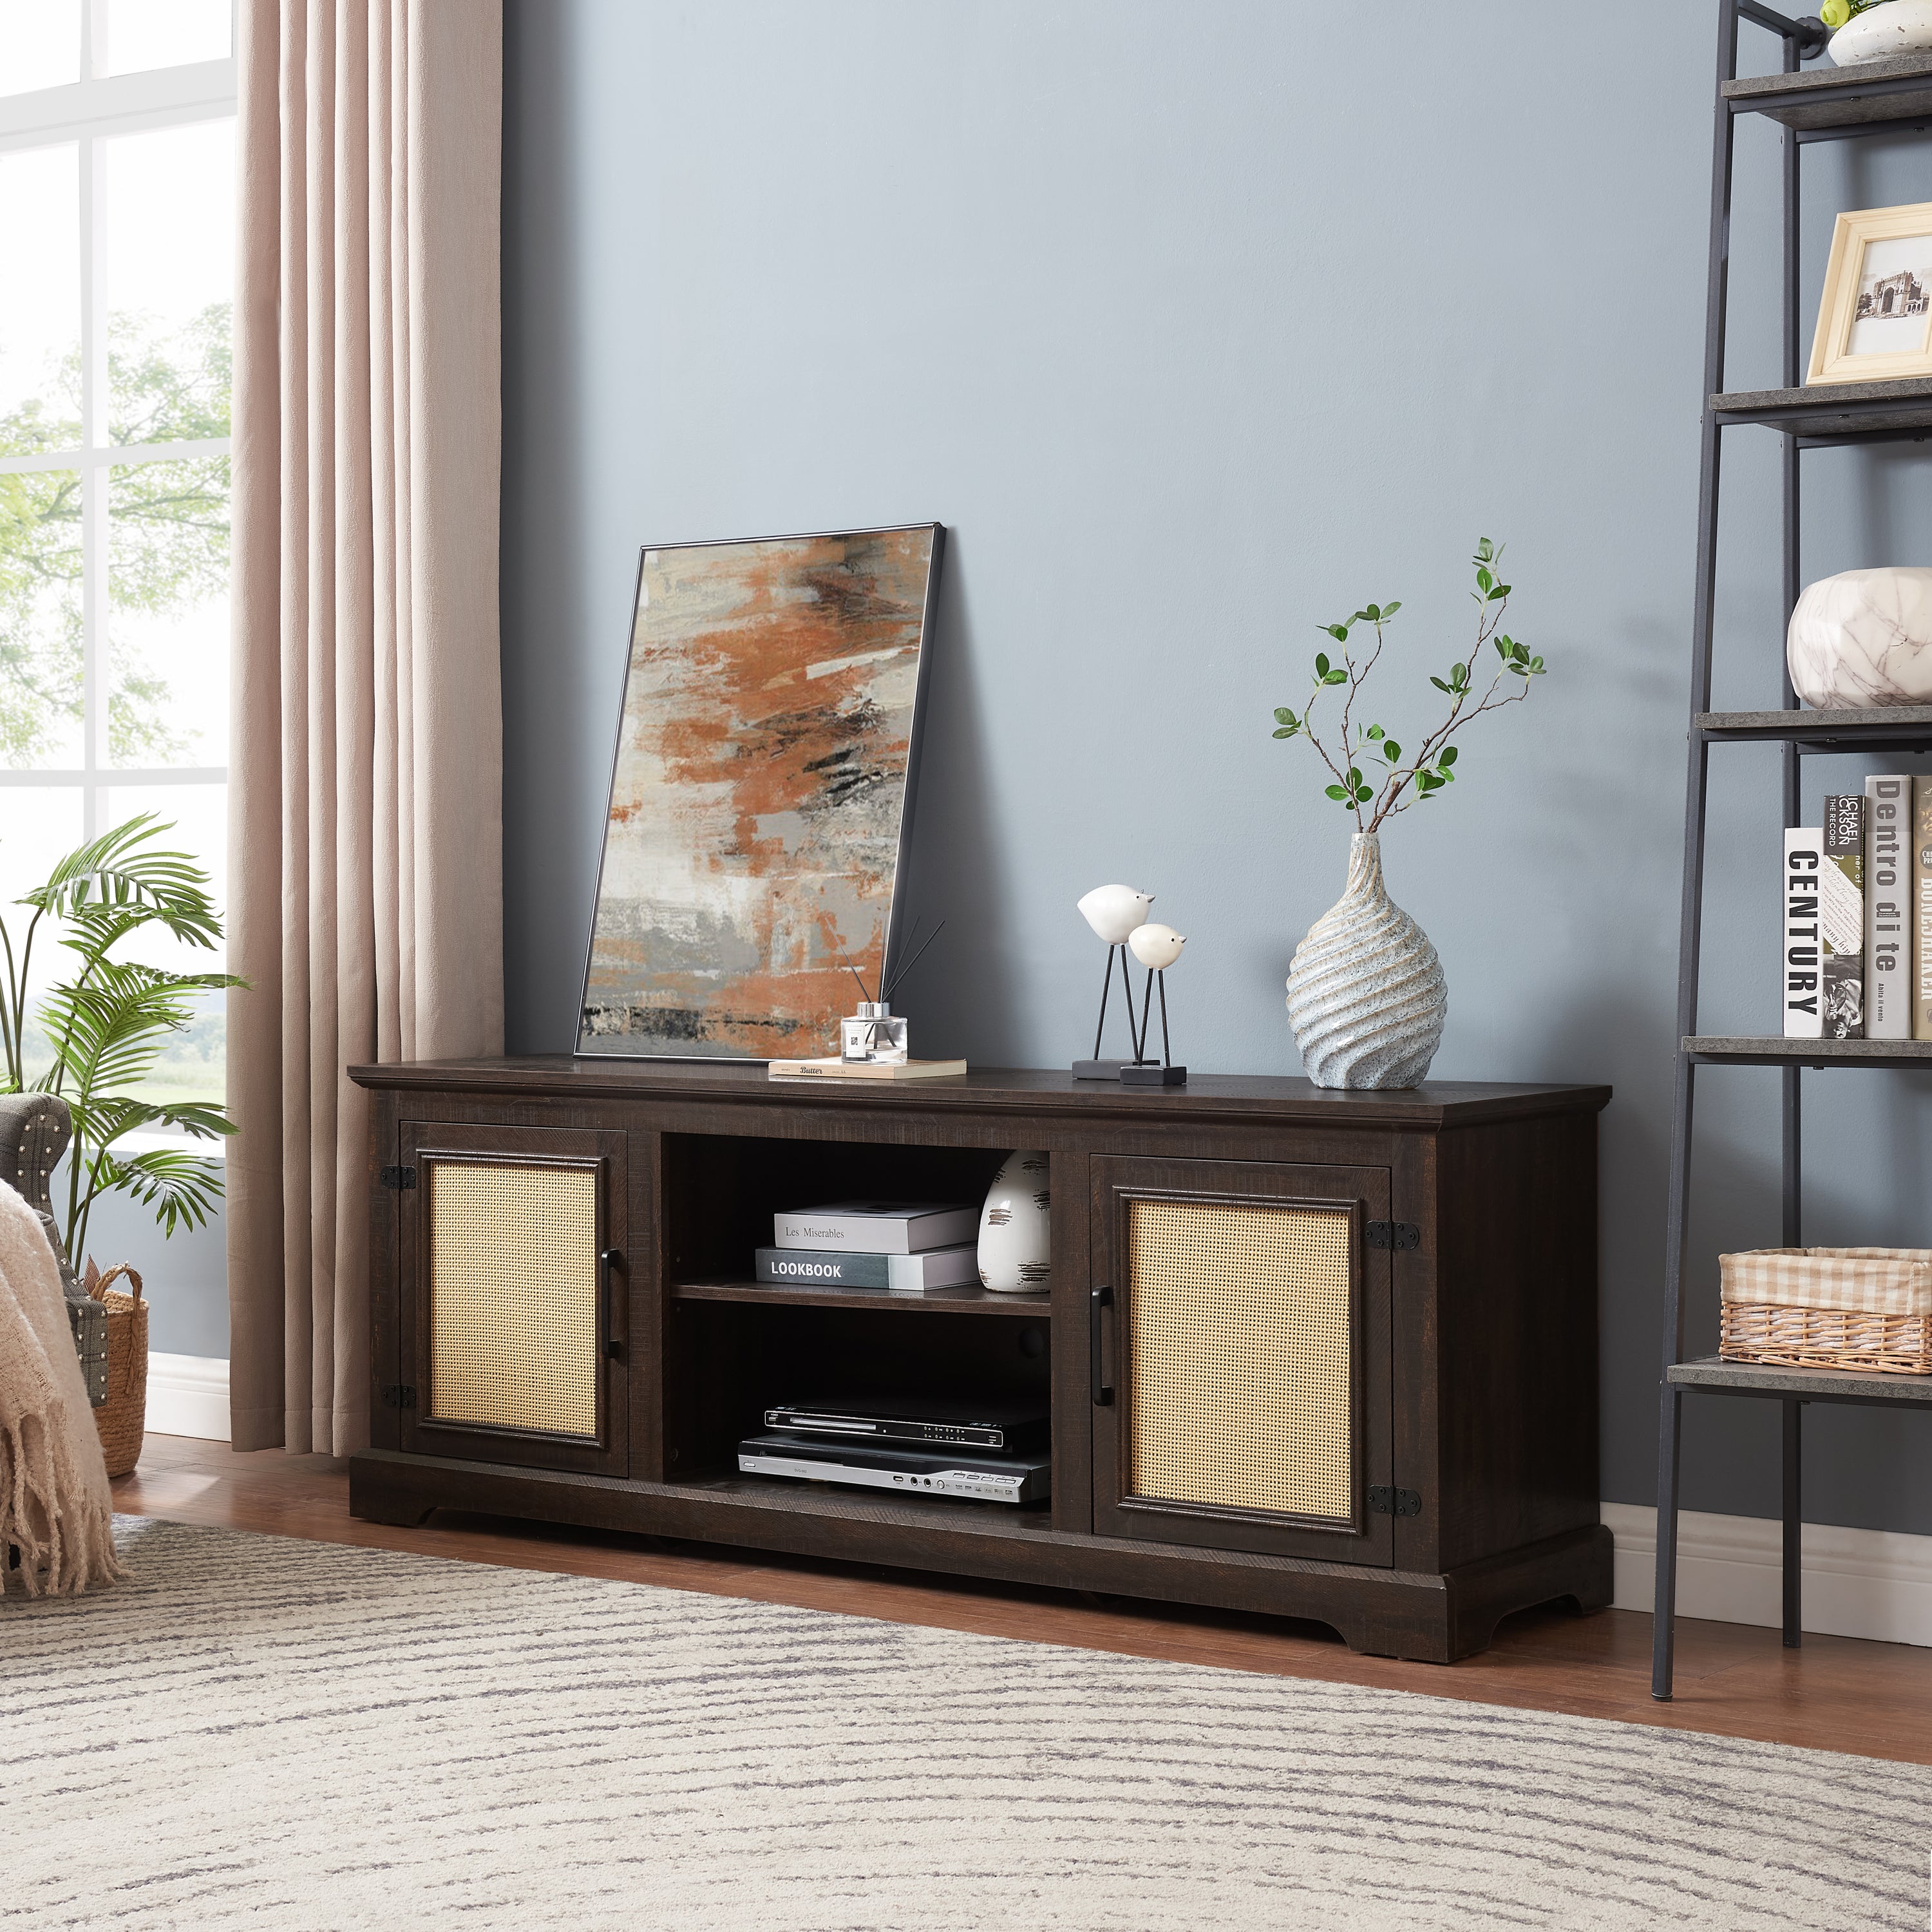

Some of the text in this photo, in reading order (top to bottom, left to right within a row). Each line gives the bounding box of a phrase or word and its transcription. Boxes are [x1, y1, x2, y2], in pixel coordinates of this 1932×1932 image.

[1848, 795, 1859, 843] ICHAEL
[1876, 781, 1900, 886] Dentro
[1875, 902, 1900, 931] di
[1788, 851, 1819, 1016] CENTURY
[1875, 942, 1900, 971] te
[799, 1066, 823, 1074] Butter
[786, 1227, 845, 1238] Les Miserables
[772, 1262, 842, 1278] LOOKBOOK
